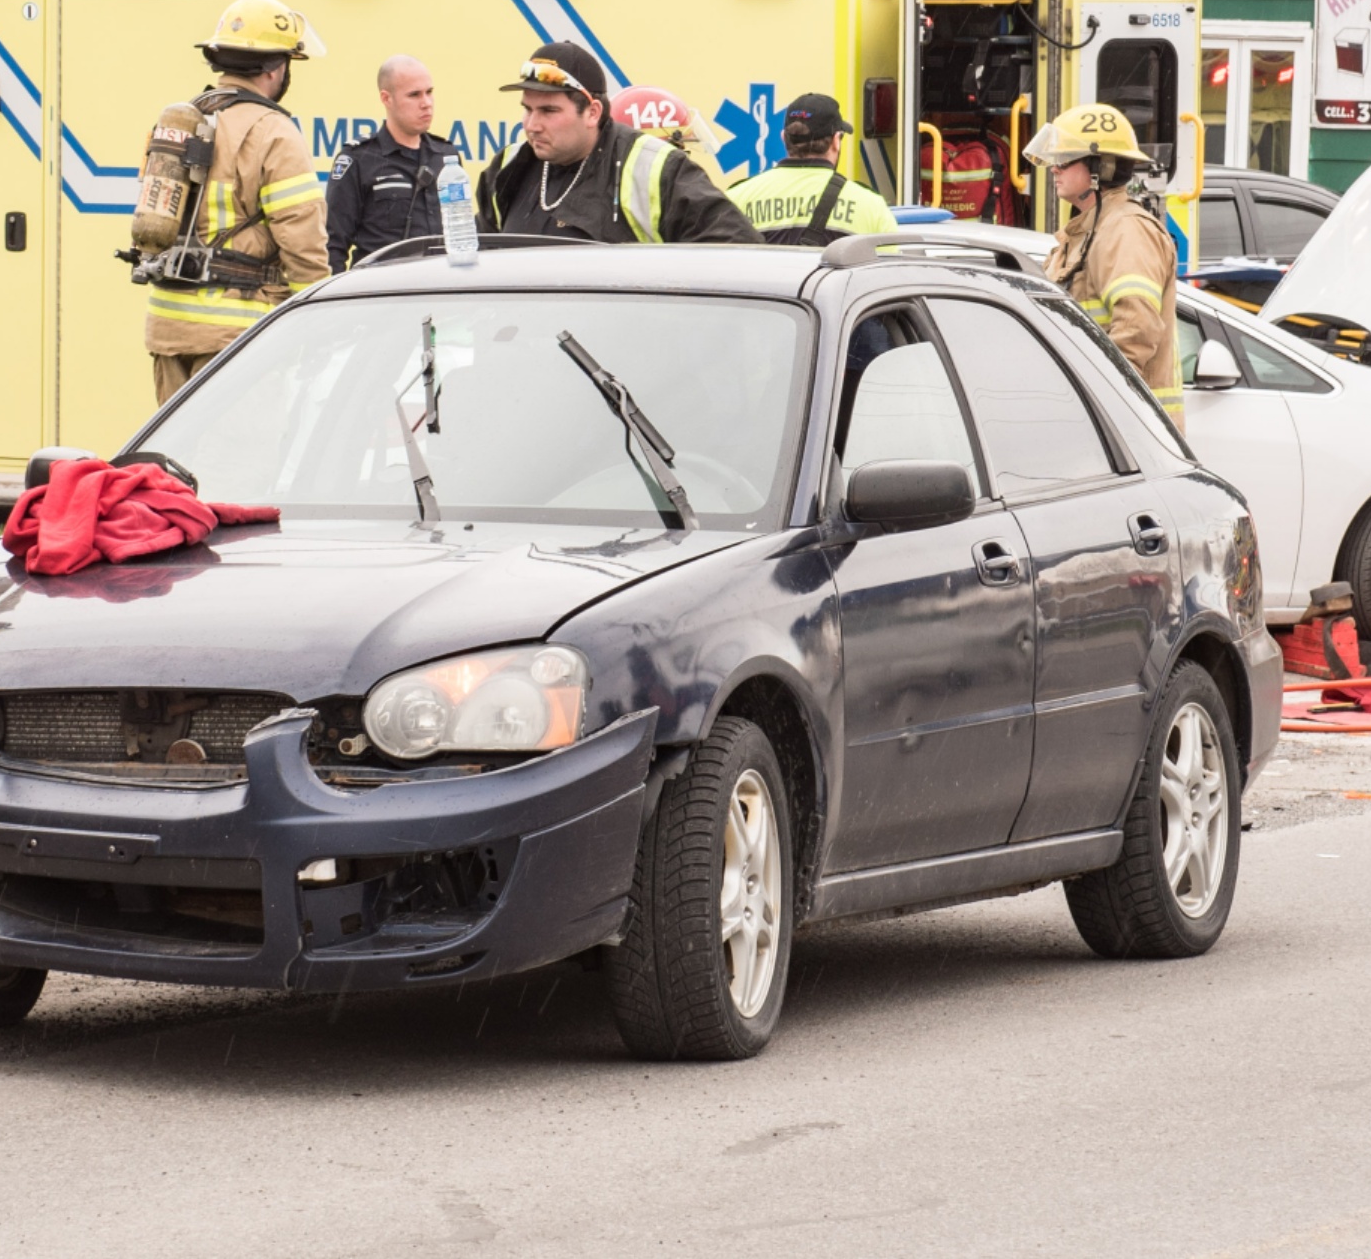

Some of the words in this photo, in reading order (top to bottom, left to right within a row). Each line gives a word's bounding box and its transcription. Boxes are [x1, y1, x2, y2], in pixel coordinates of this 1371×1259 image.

[1152, 13, 1180, 27] 6518
[624, 100, 680, 130] 142
[1080, 112, 1118, 133] 28
[147, 178, 162, 210] SCOTT
[168, 183, 184, 216] SCOTT
[745, 194, 857, 224] AMBULACE
